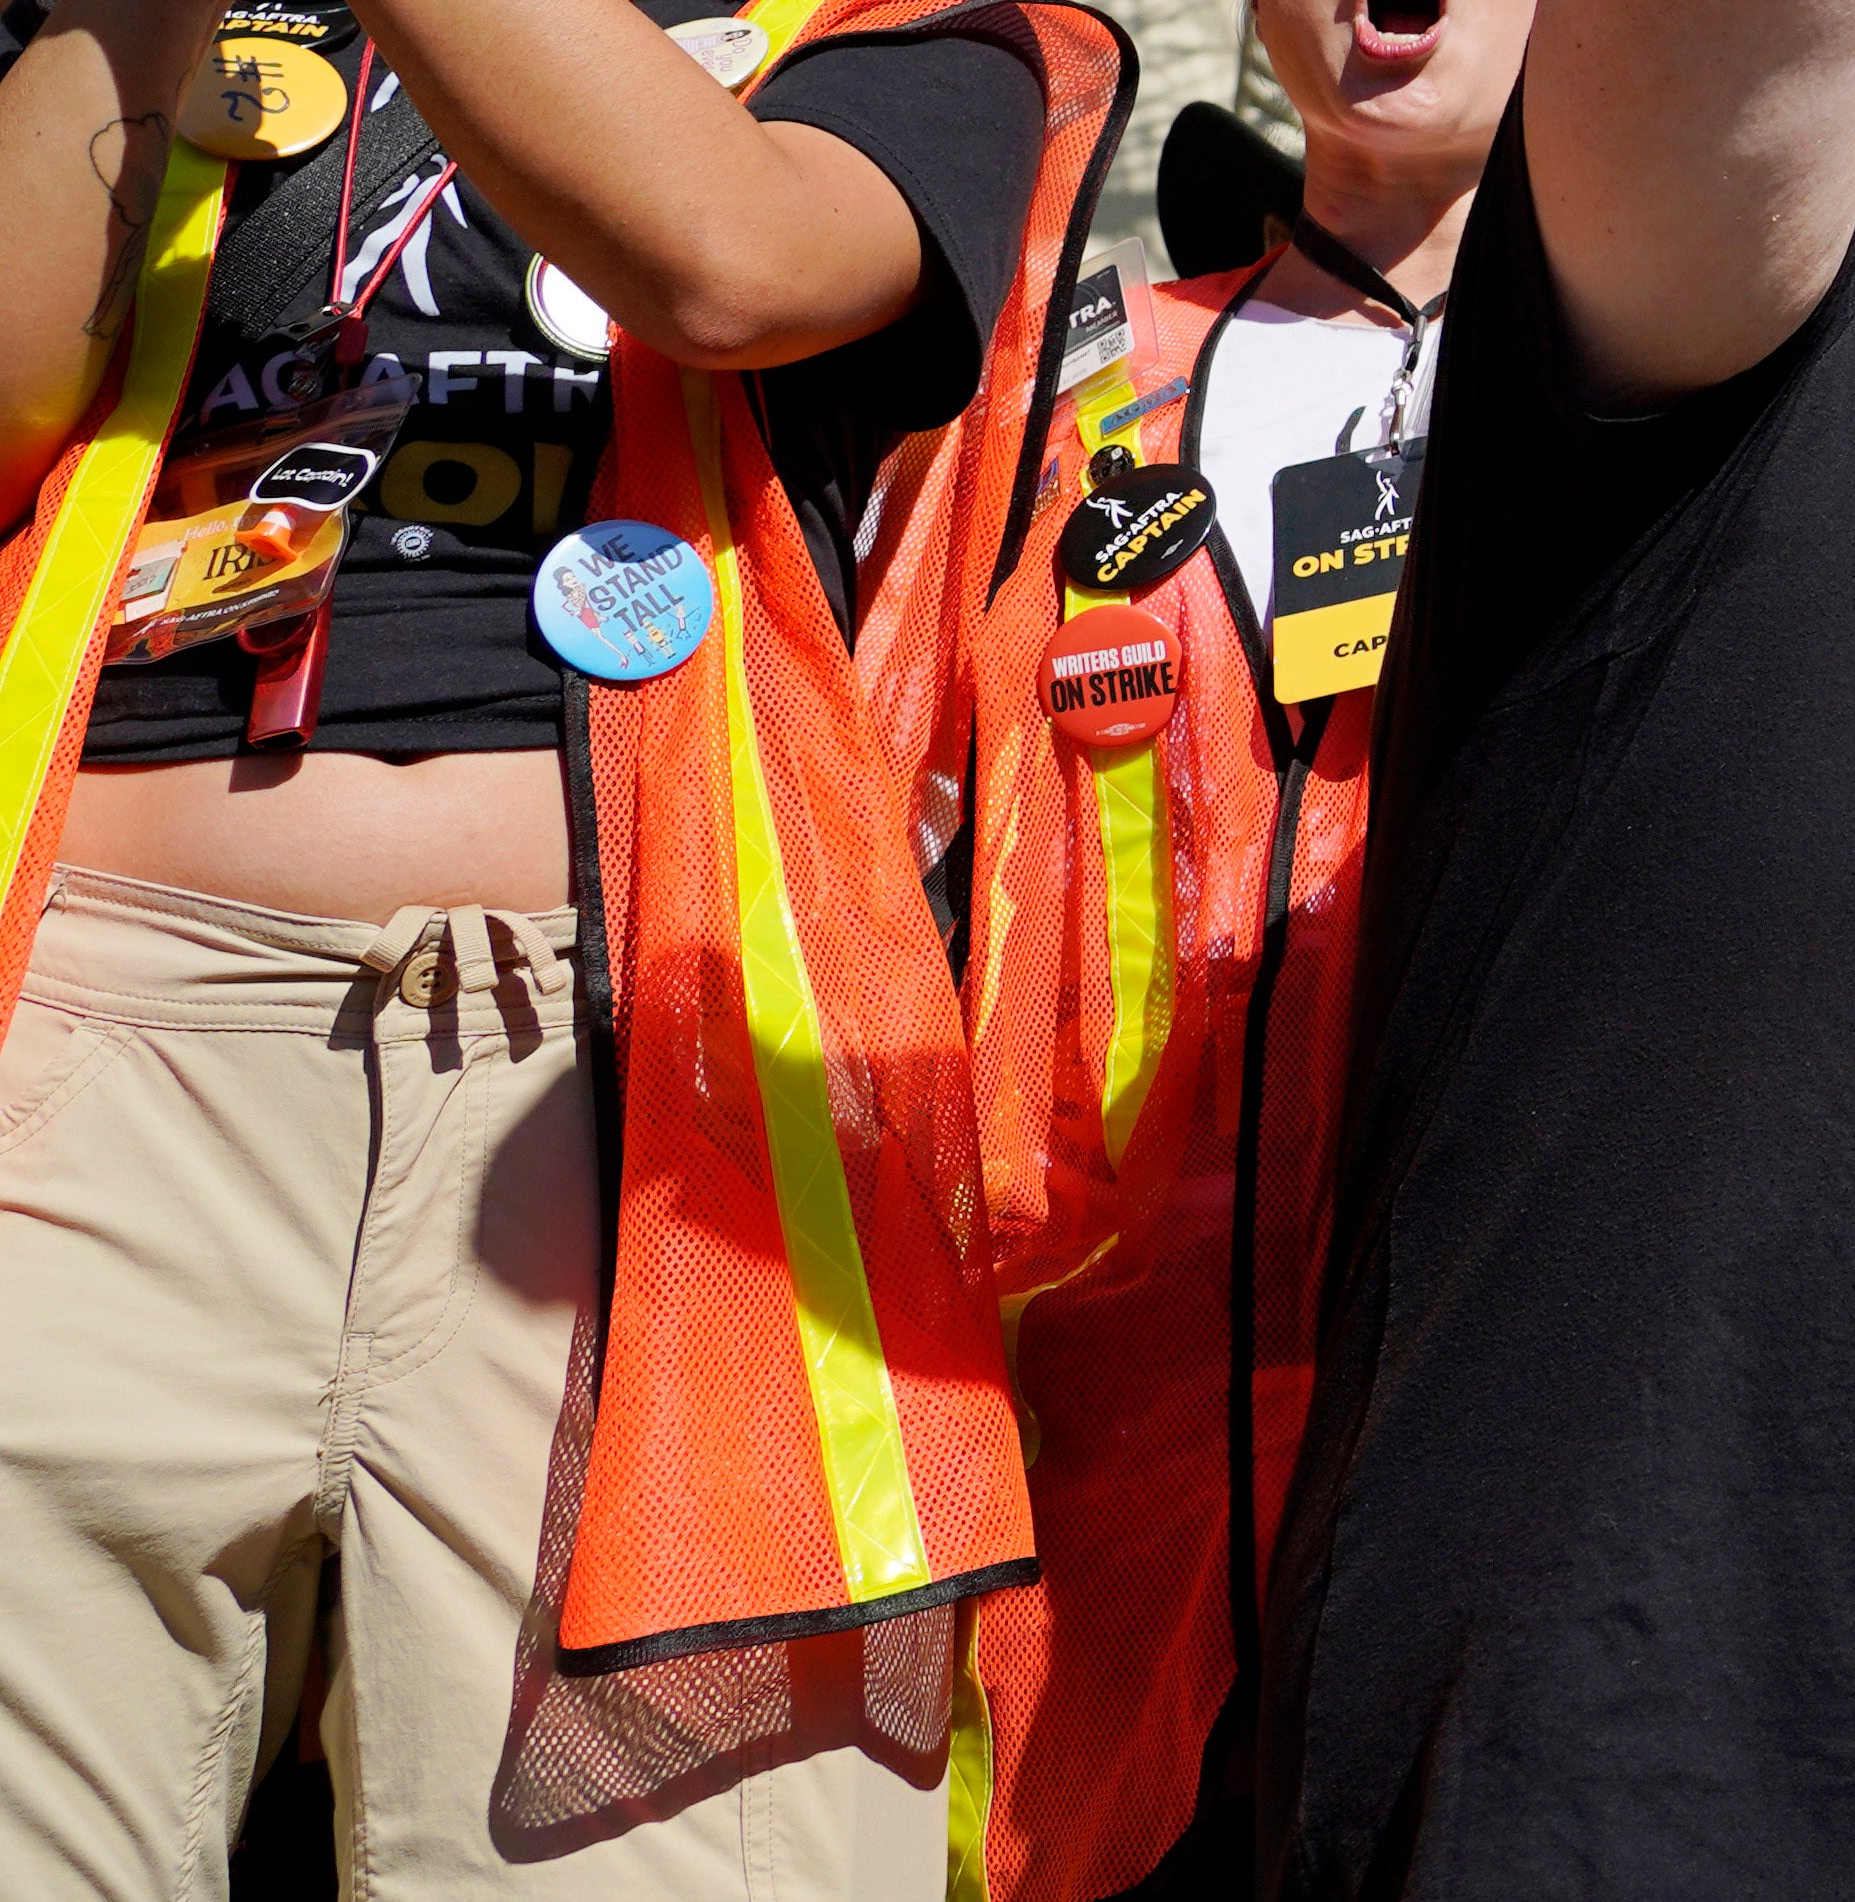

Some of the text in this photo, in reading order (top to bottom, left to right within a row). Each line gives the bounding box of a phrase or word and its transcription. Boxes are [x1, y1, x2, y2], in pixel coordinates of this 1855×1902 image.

[217, 19, 329, 38] APTAIN
[578, 534, 635, 578] WE
[1096, 489, 1207, 582] CAPTAIN
[588, 544, 683, 612] STAND
[1292, 548, 1345, 578] ON
[613, 584, 685, 632] TALL
[1052, 640, 1166, 678] WRITERS GUILD
[1334, 635, 1387, 658] CAP
[1050, 661, 1177, 713] ON STRIKE
